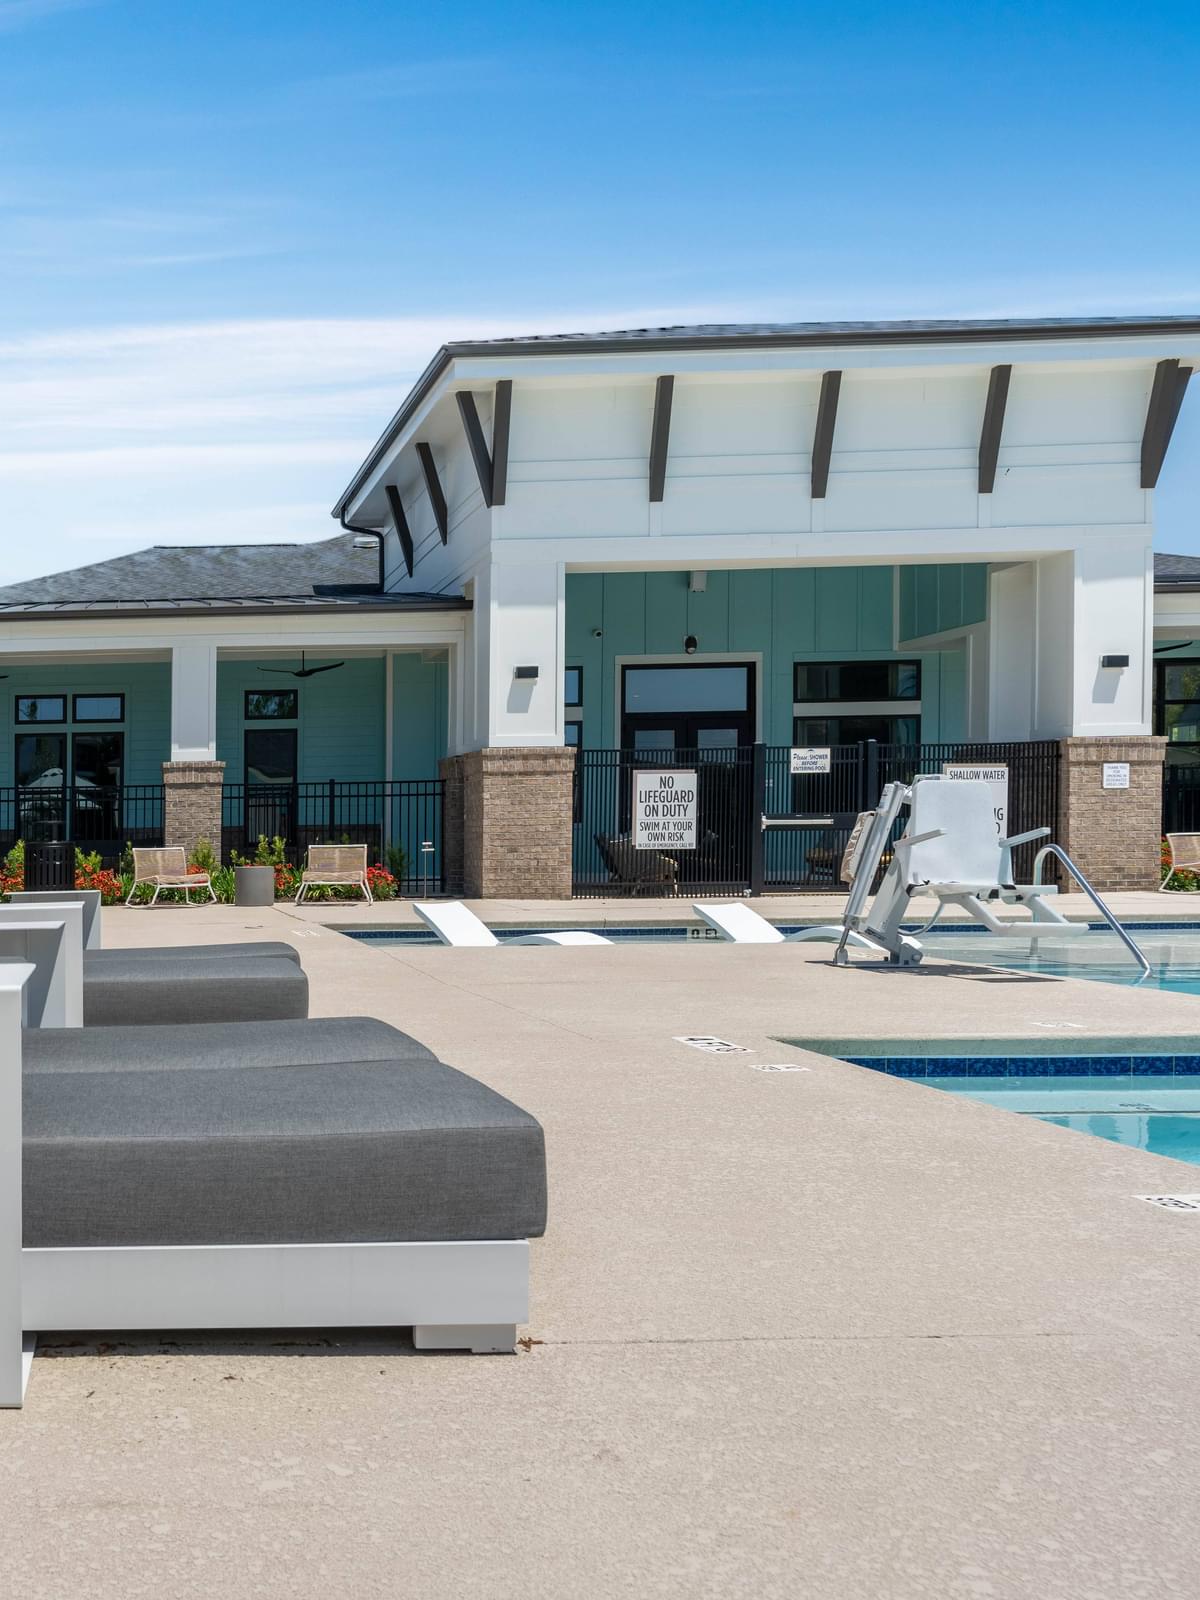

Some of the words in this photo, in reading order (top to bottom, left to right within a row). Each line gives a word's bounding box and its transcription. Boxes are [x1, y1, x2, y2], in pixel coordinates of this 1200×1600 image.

[949, 770, 980, 780] SHALLOW
[982, 770, 1006, 780] WATER
[660, 776, 674, 789] NO
[639, 790, 694, 803] LIFEGUARD
[644, 804, 659, 817] ON
[662, 804, 689, 817] DUTY
[639, 821, 659, 831] SWIM
[661, 821, 670, 831] AT
[672, 821, 693, 831] YOUR
[647, 832, 666, 842] OWN
[667, 831, 685, 841] RISK
